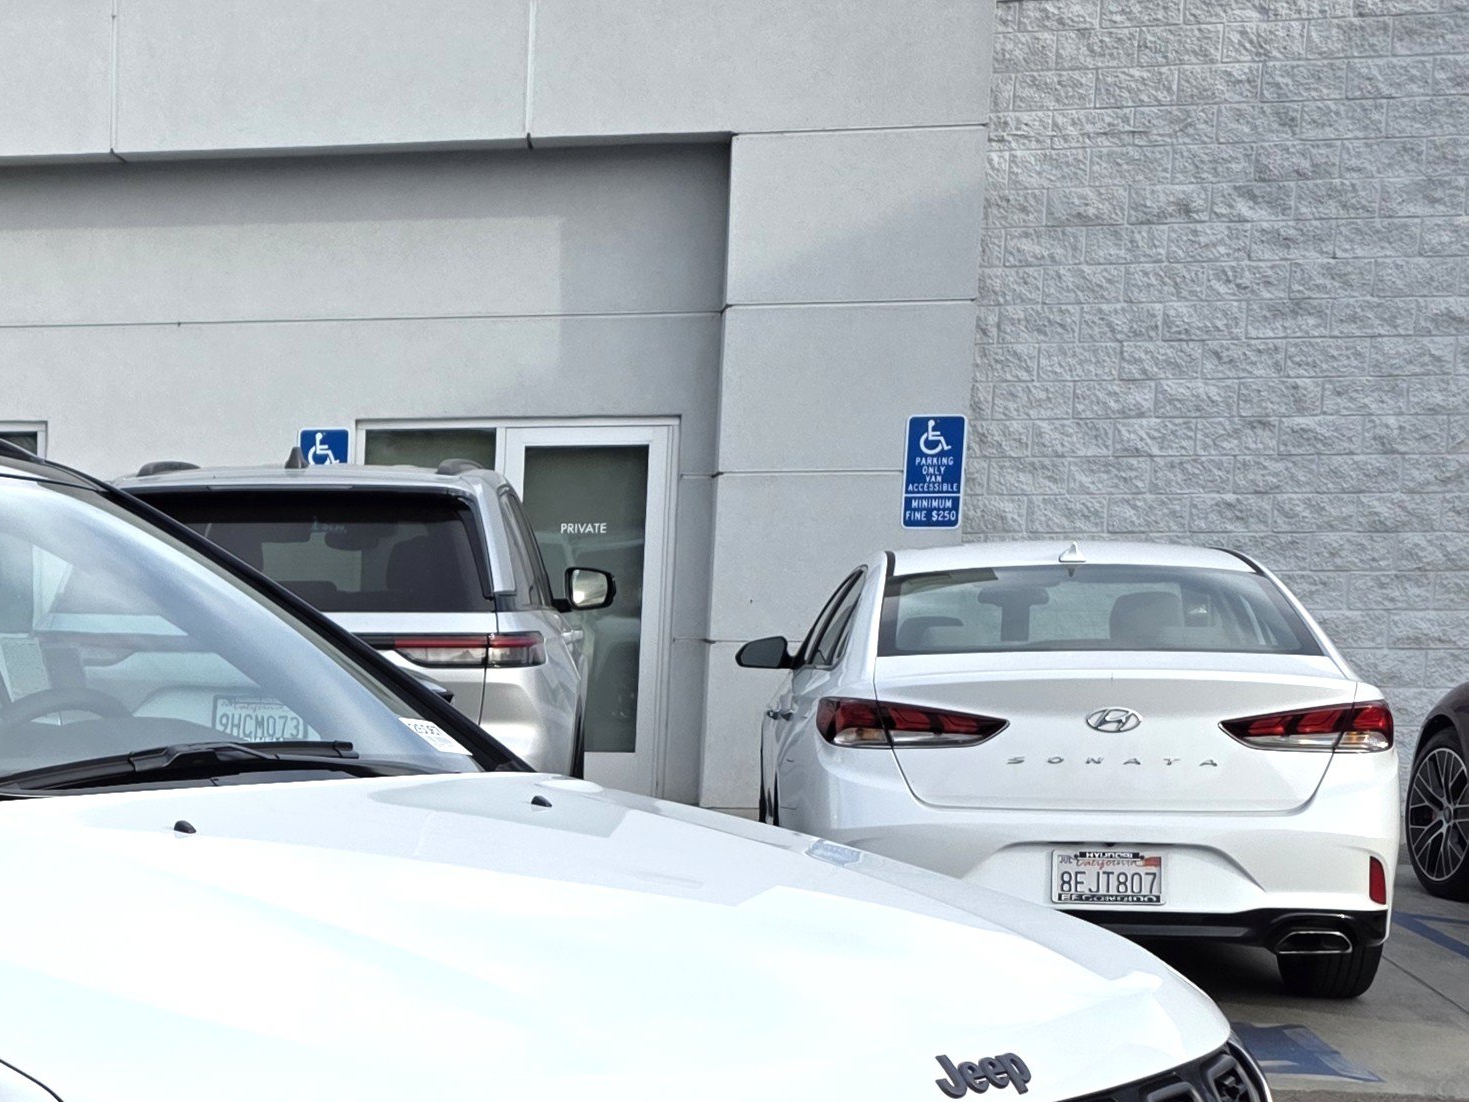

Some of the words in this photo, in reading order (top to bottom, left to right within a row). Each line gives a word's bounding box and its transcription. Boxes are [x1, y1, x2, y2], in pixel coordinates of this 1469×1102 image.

[915, 456, 954, 466] PARKING
[922, 466, 946, 475] ONLY
[925, 475, 942, 483] VAN
[907, 483, 958, 492] ACCESSIBLE
[911, 498, 952, 509] MINIMUM
[905, 510, 927, 521] FINE
[931, 510, 956, 521] $250
[560, 522, 607, 534] PRIVATE
[219, 712, 300, 738] 9HCM073
[1006, 756, 1218, 767] SONATA
[1060, 870, 1157, 894] 8EJT807
[935, 1052, 1032, 1099] Jeep
